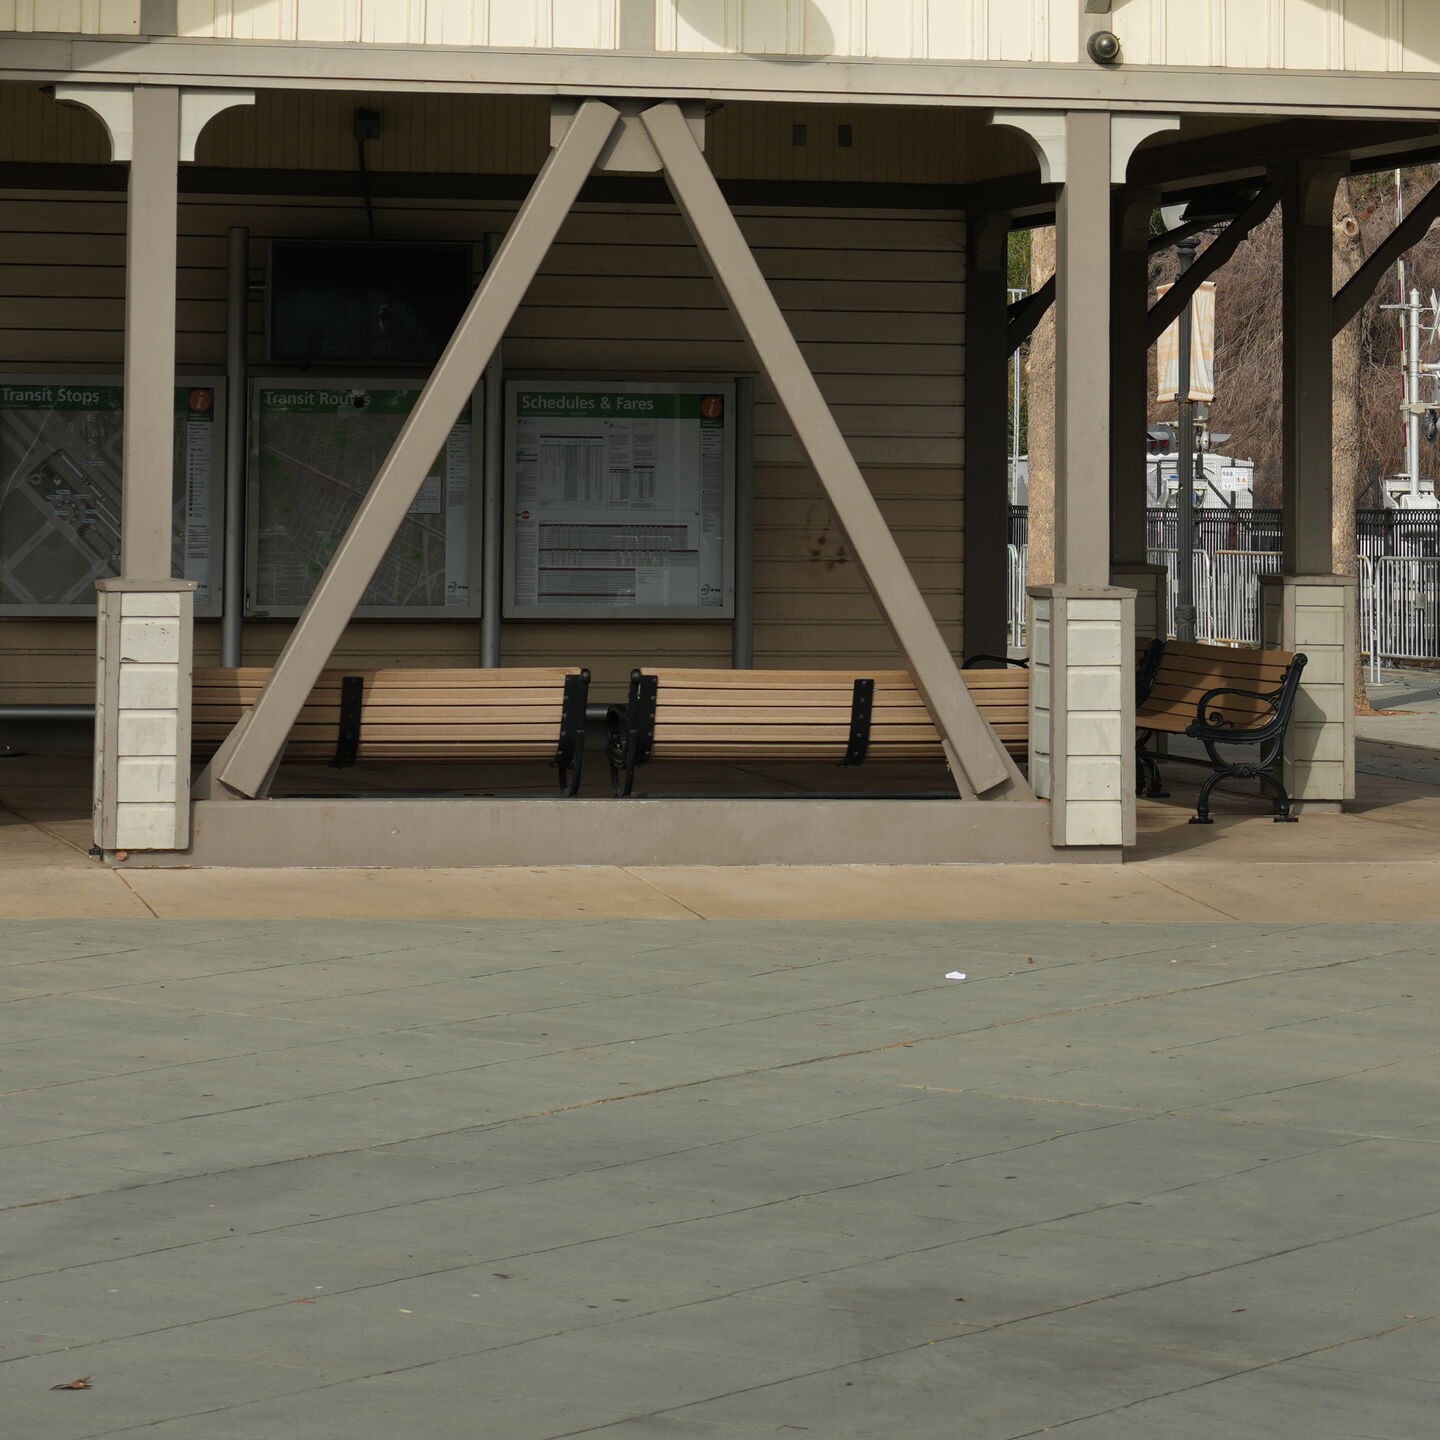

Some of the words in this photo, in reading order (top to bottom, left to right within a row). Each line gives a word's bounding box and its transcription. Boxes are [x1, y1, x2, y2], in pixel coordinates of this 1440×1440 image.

[0, 387, 53, 402] Transit
[57, 388, 101, 406] Stops
[264, 390, 315, 406] Transit
[319, 391, 371, 407] Routs
[521, 395, 596, 410] Schedules
[600, 396, 611, 410] &
[616, 396, 655, 411] Fares
